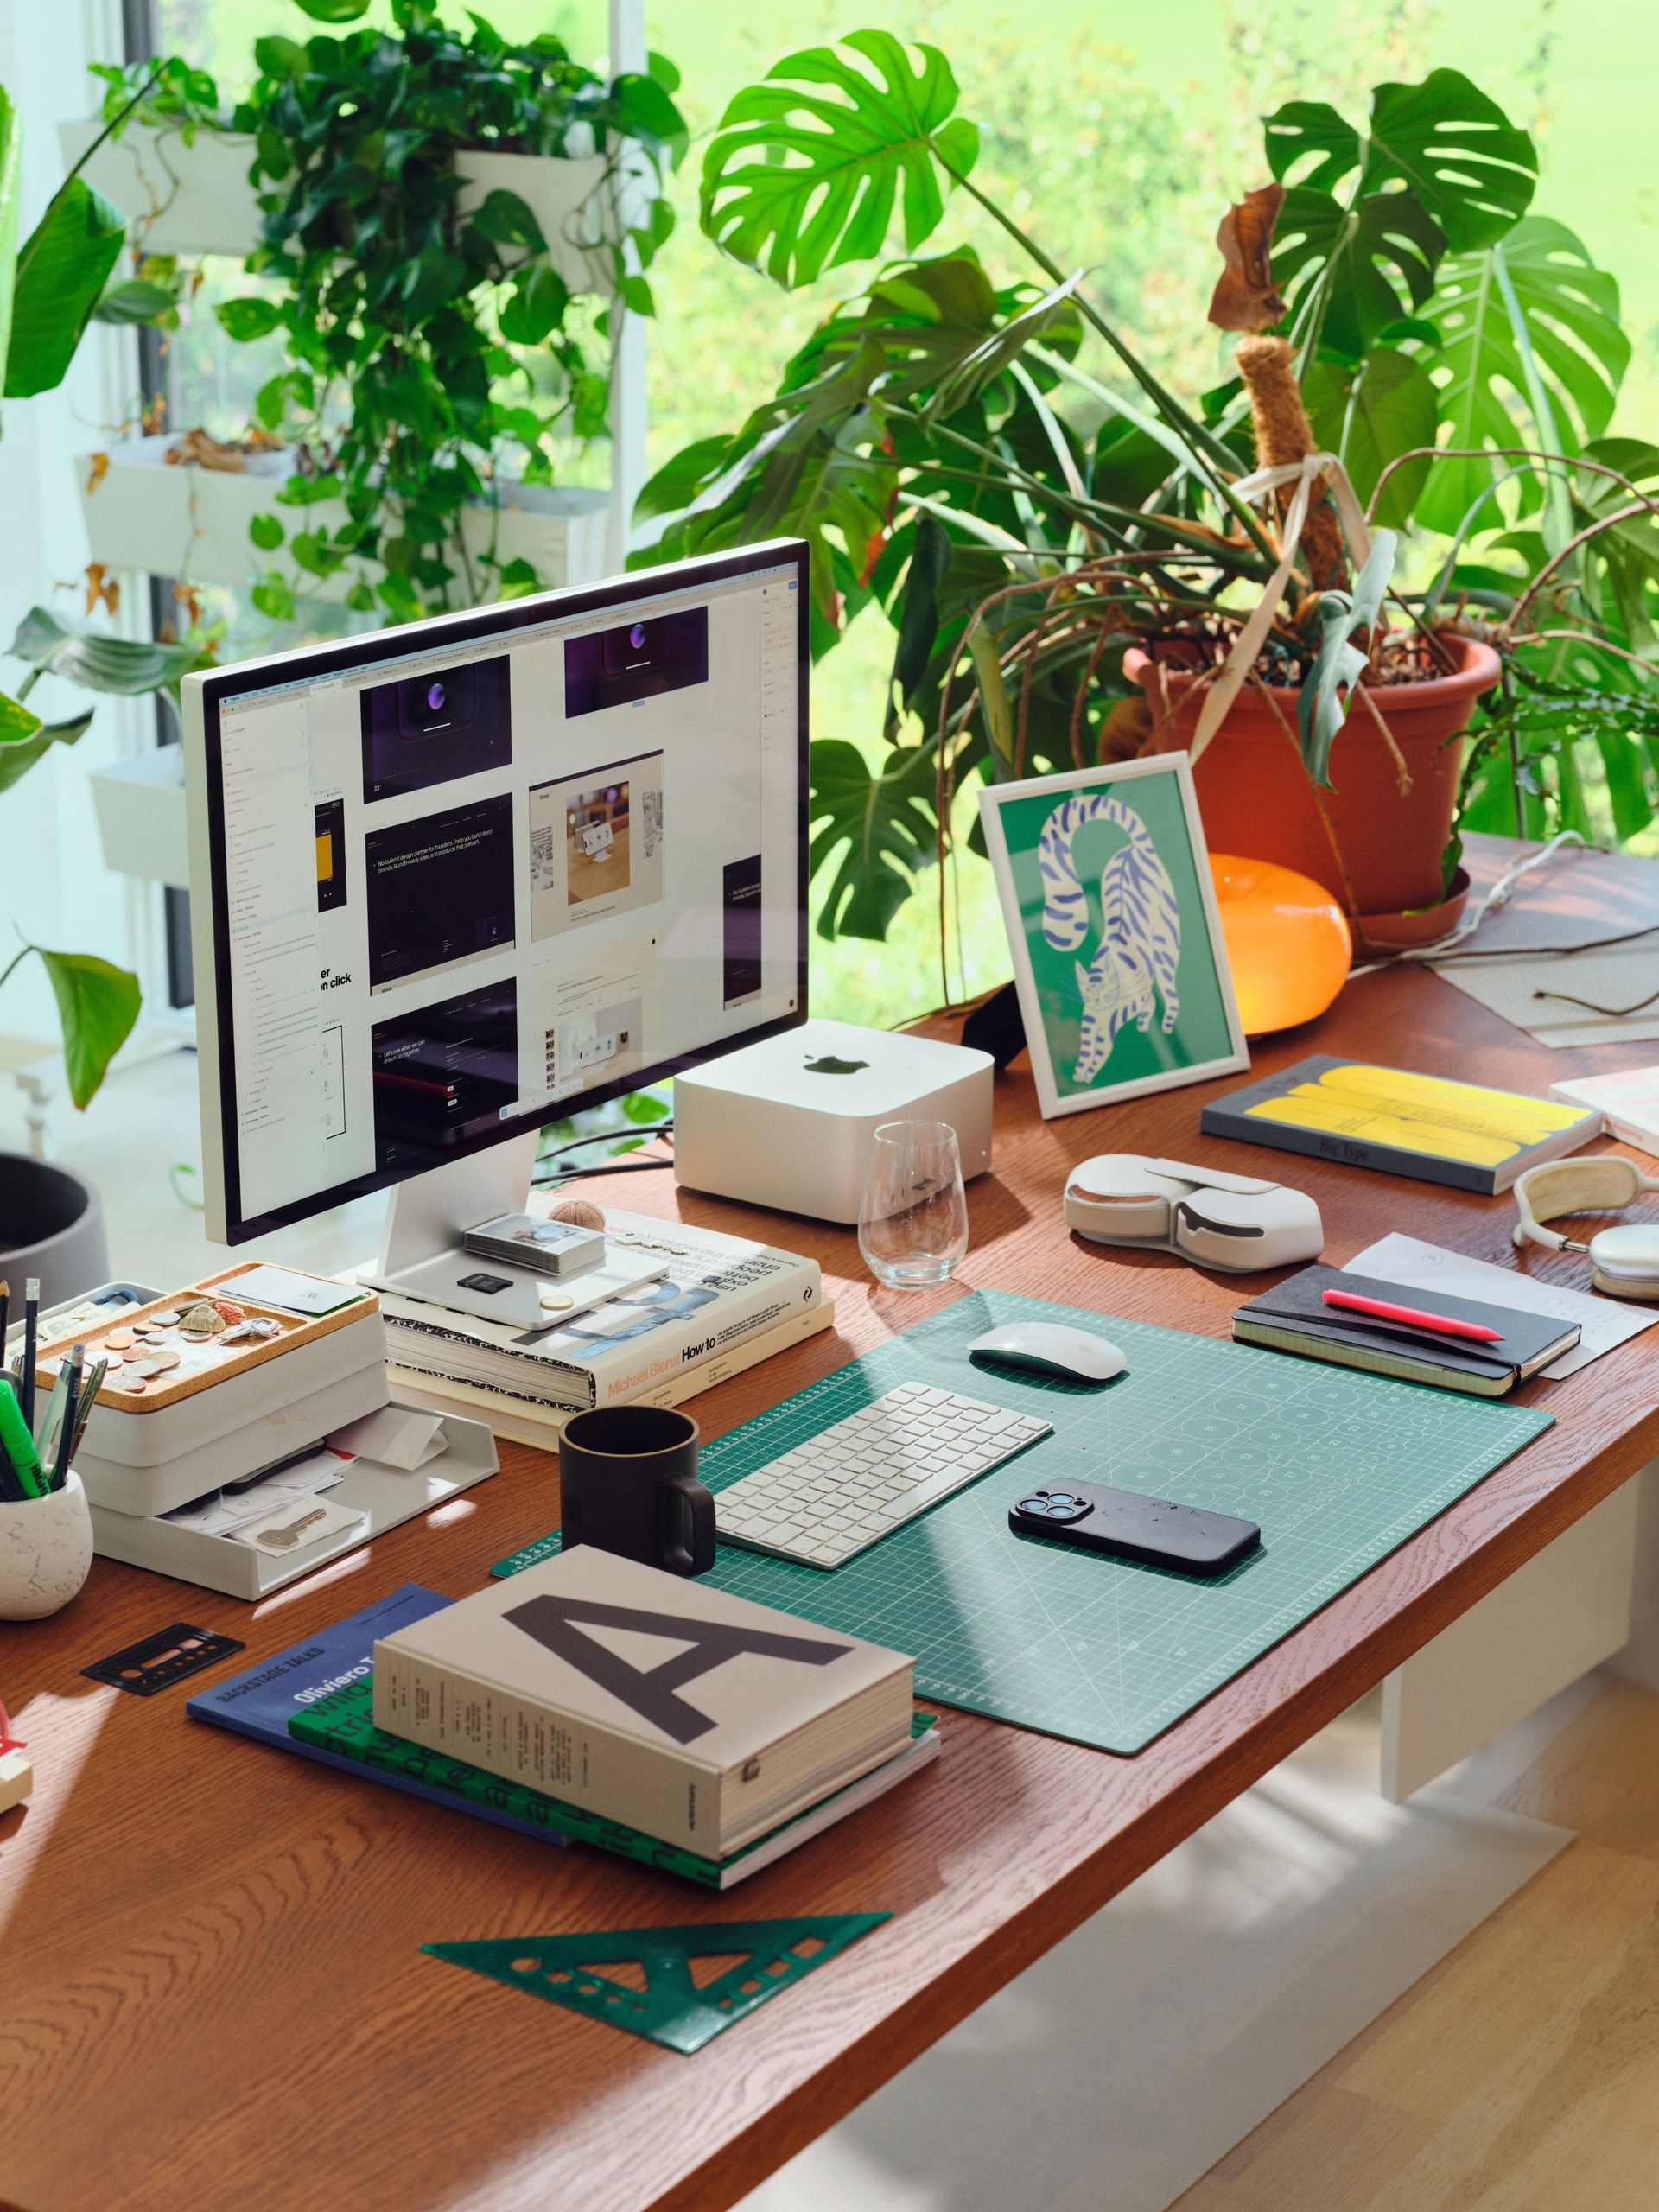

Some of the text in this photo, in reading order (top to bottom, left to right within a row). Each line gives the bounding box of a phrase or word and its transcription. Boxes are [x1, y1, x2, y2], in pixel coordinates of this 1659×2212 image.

[321, 969, 331, 978] er
[330, 973, 352, 988] click
[1319, 1137, 1369, 1161] Big Type
[708, 1282, 737, 1293] use
[607, 1337, 716, 1398] Michael Bierut How to
[216, 1646, 326, 1704] BACKSTAGE TALKS
[293, 1665, 370, 1705] Oliviero
[501, 1593, 855, 1745] A
